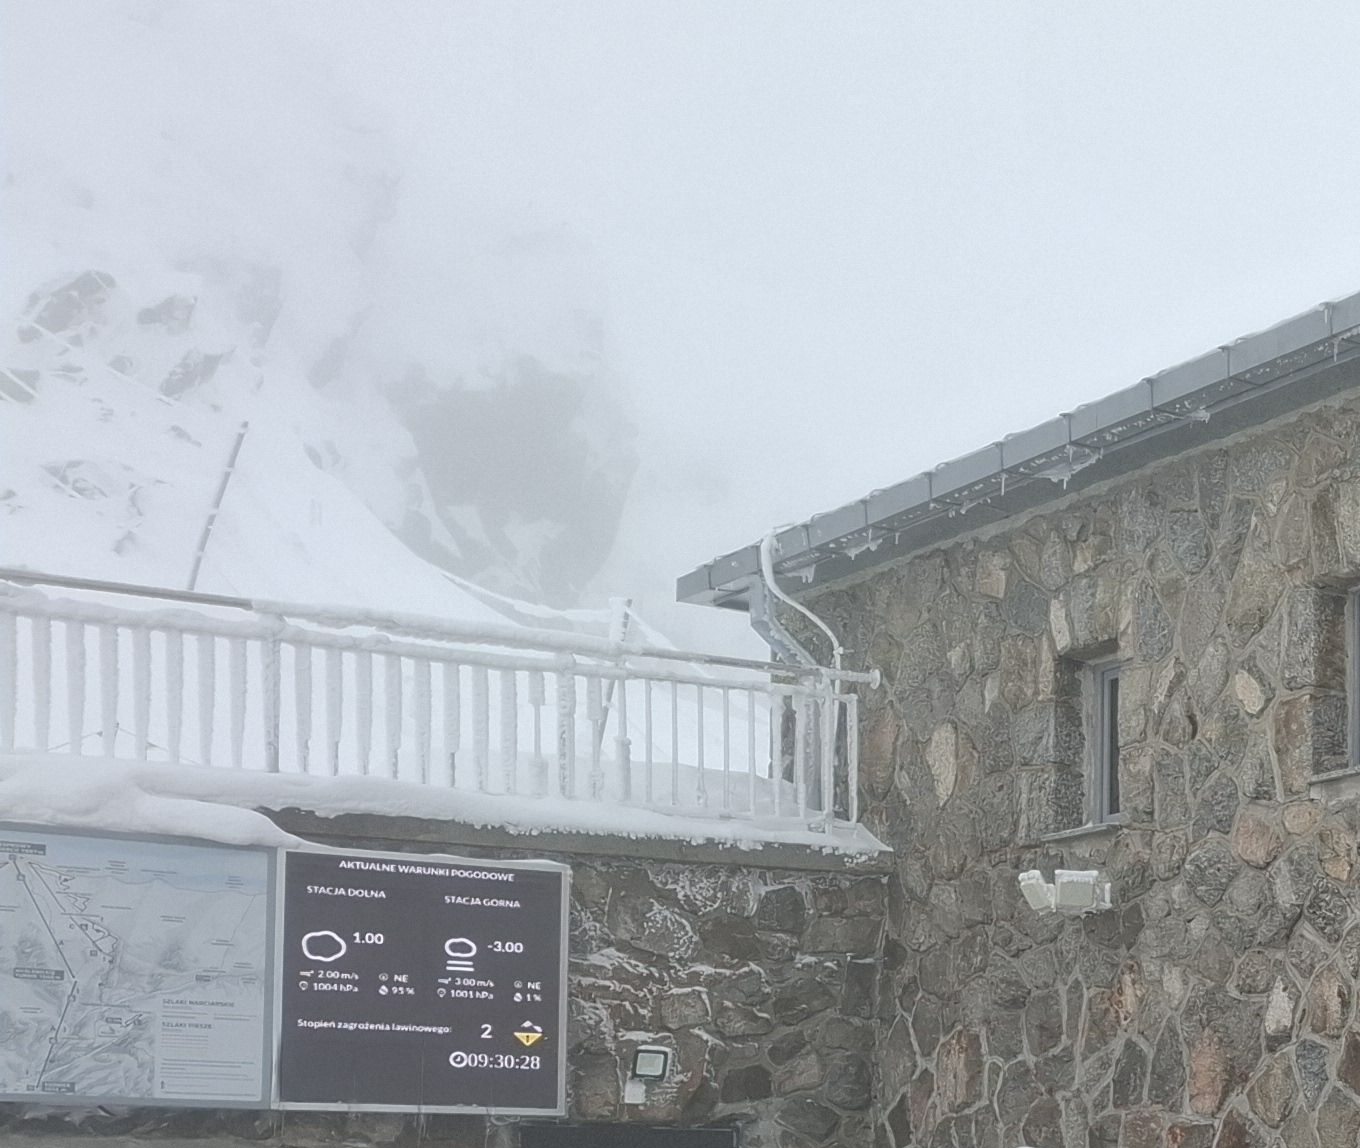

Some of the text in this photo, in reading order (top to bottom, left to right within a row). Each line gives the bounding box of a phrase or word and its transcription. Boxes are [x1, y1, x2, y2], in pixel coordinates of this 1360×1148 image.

[339, 860, 515, 882] AKTUALNE WARUNKI POGODOWE
[307, 885, 386, 899] STACJA DOLNA
[444, 895, 481, 906] STACJA
[352, 932, 384, 945] 1.00
[487, 941, 524, 954] -3.00
[394, 974, 408, 983] NE
[527, 981, 541, 990] NE
[481, 1024, 492, 1039] 2
[467, 1053, 541, 1070] 09:30:28
